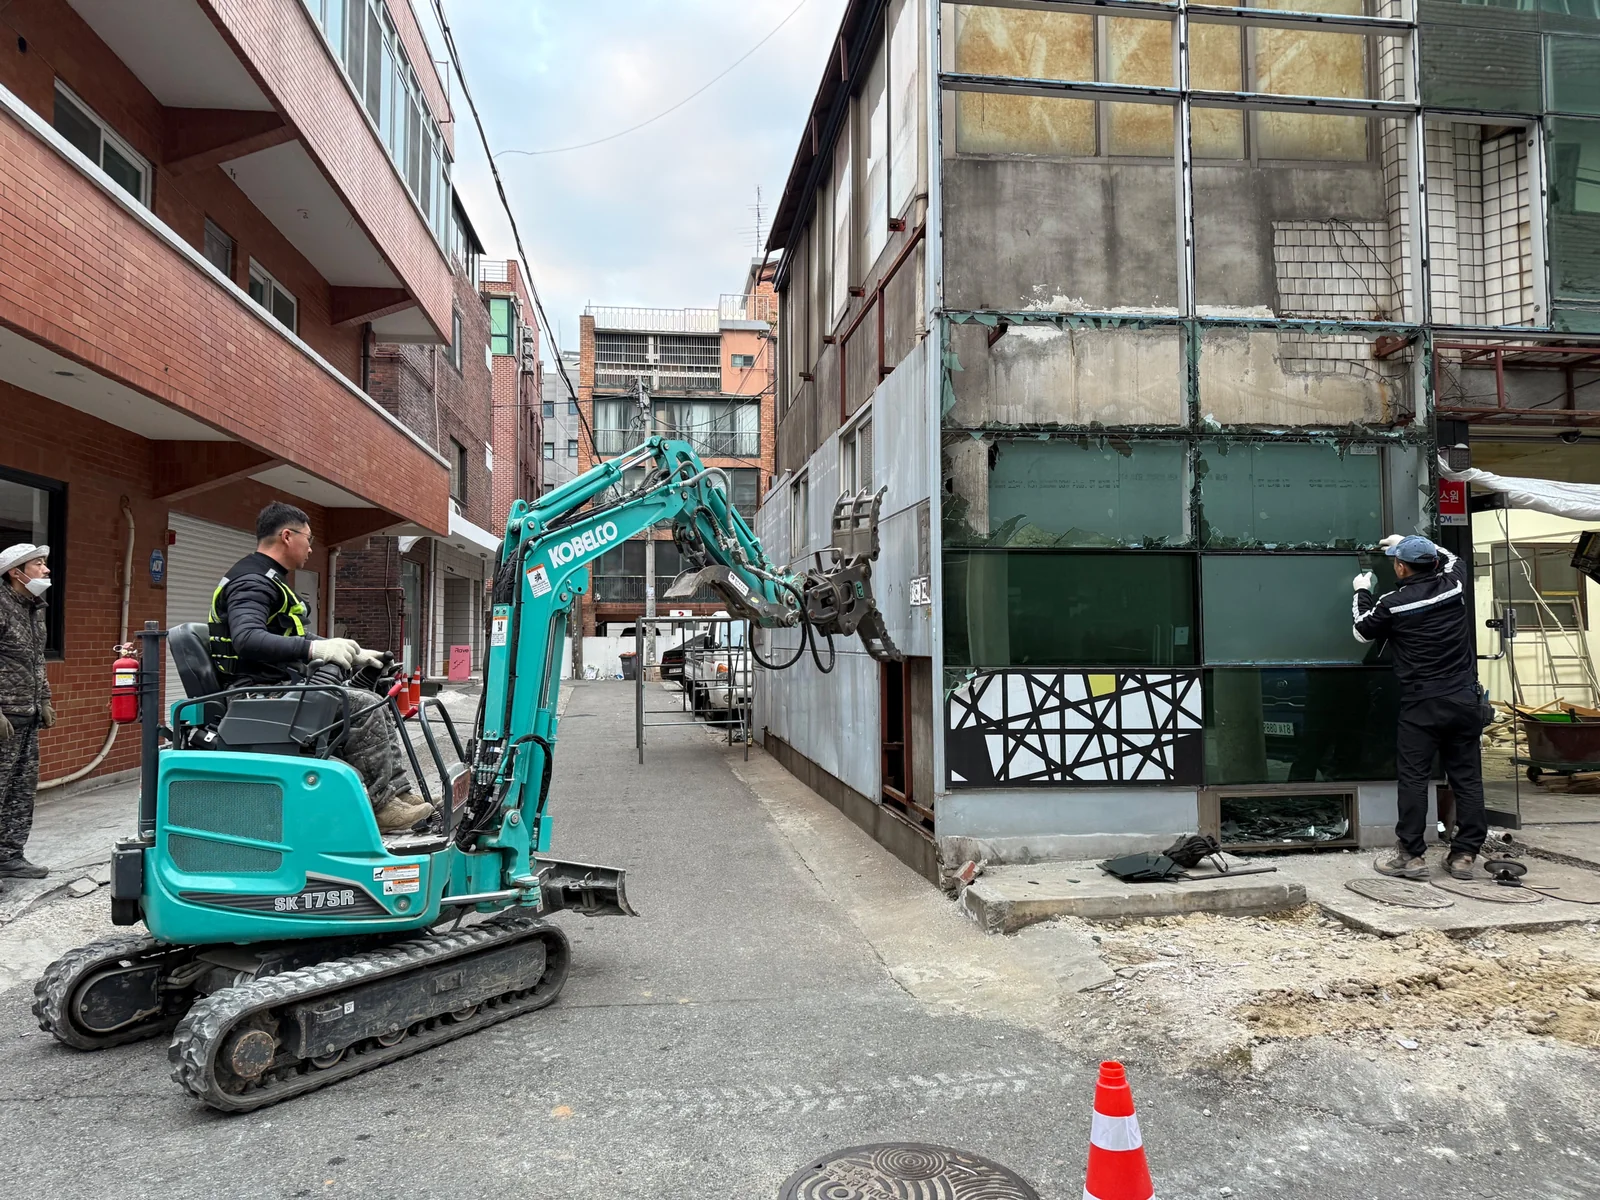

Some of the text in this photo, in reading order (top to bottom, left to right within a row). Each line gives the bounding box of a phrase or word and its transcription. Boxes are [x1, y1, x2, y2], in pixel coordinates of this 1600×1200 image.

[548, 521, 618, 569] KOBELCO
[274, 889, 355, 912] SK 17SR
